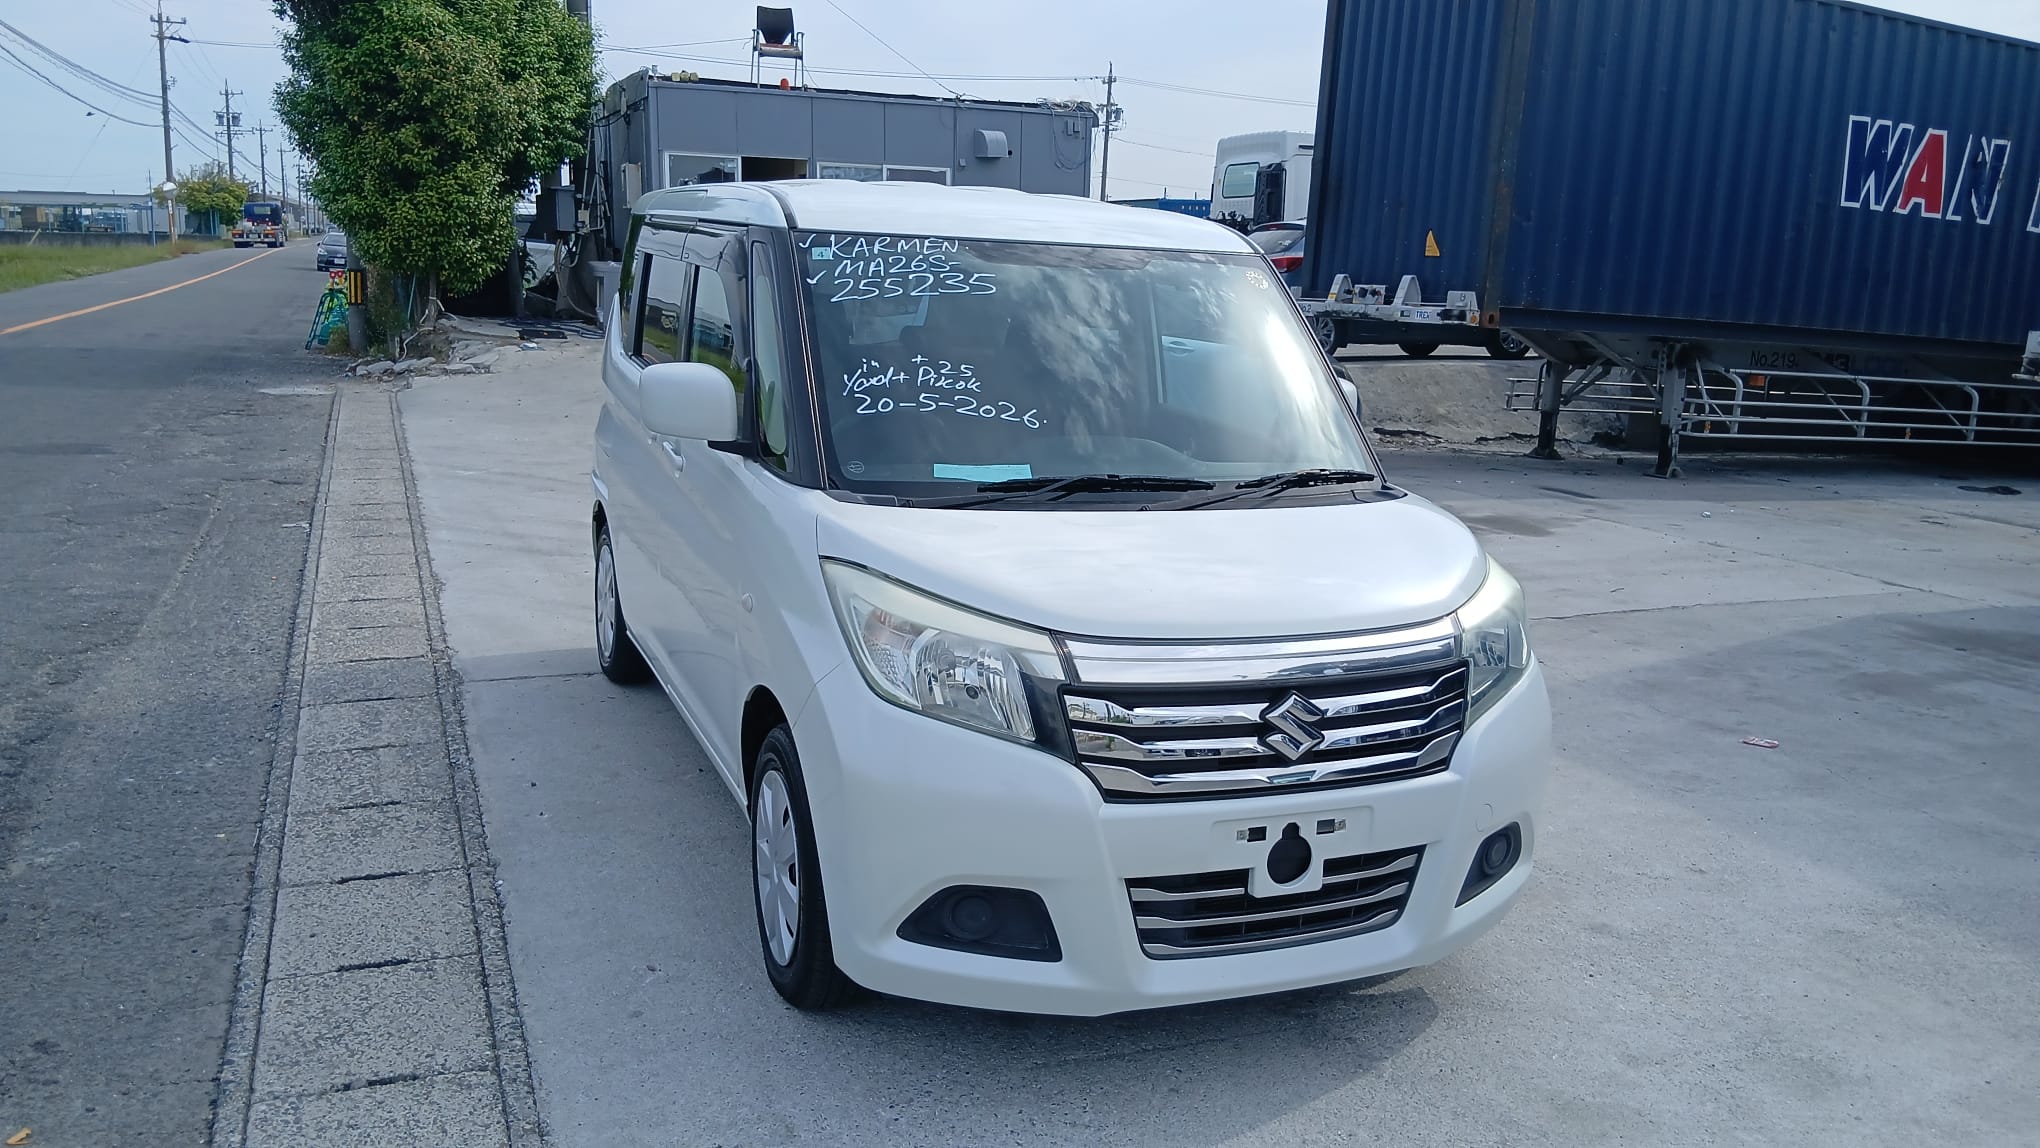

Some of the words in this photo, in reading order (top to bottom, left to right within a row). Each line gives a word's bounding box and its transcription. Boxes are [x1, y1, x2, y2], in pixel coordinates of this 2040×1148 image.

[1841, 115, 2012, 225] WAN
[830, 273, 997, 302] 255235
[938, 361, 975, 378] 25
